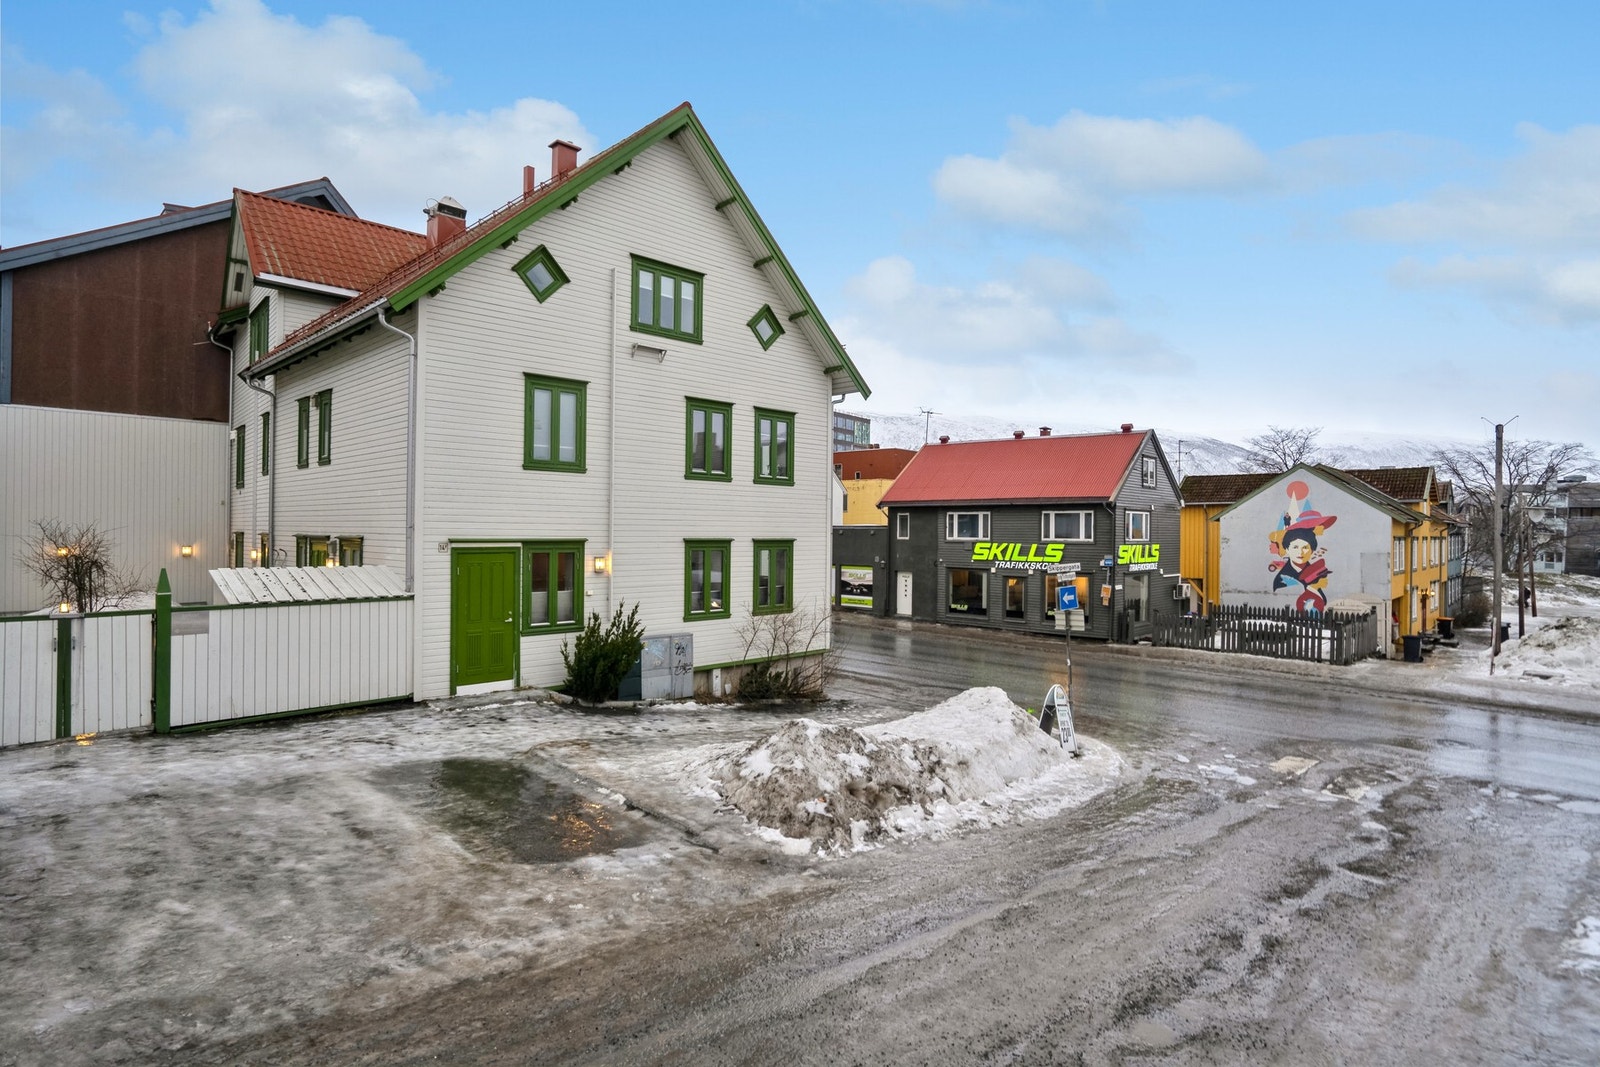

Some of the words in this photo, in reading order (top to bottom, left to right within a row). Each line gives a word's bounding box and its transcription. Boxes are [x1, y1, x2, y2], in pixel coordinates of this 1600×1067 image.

[971, 542, 1065, 562] SKILLS
[1117, 543, 1160, 564] SKILLS
[994, 561, 1059, 570] TRAFIKKSKO
[1048, 564, 1080, 572] Skippergata
